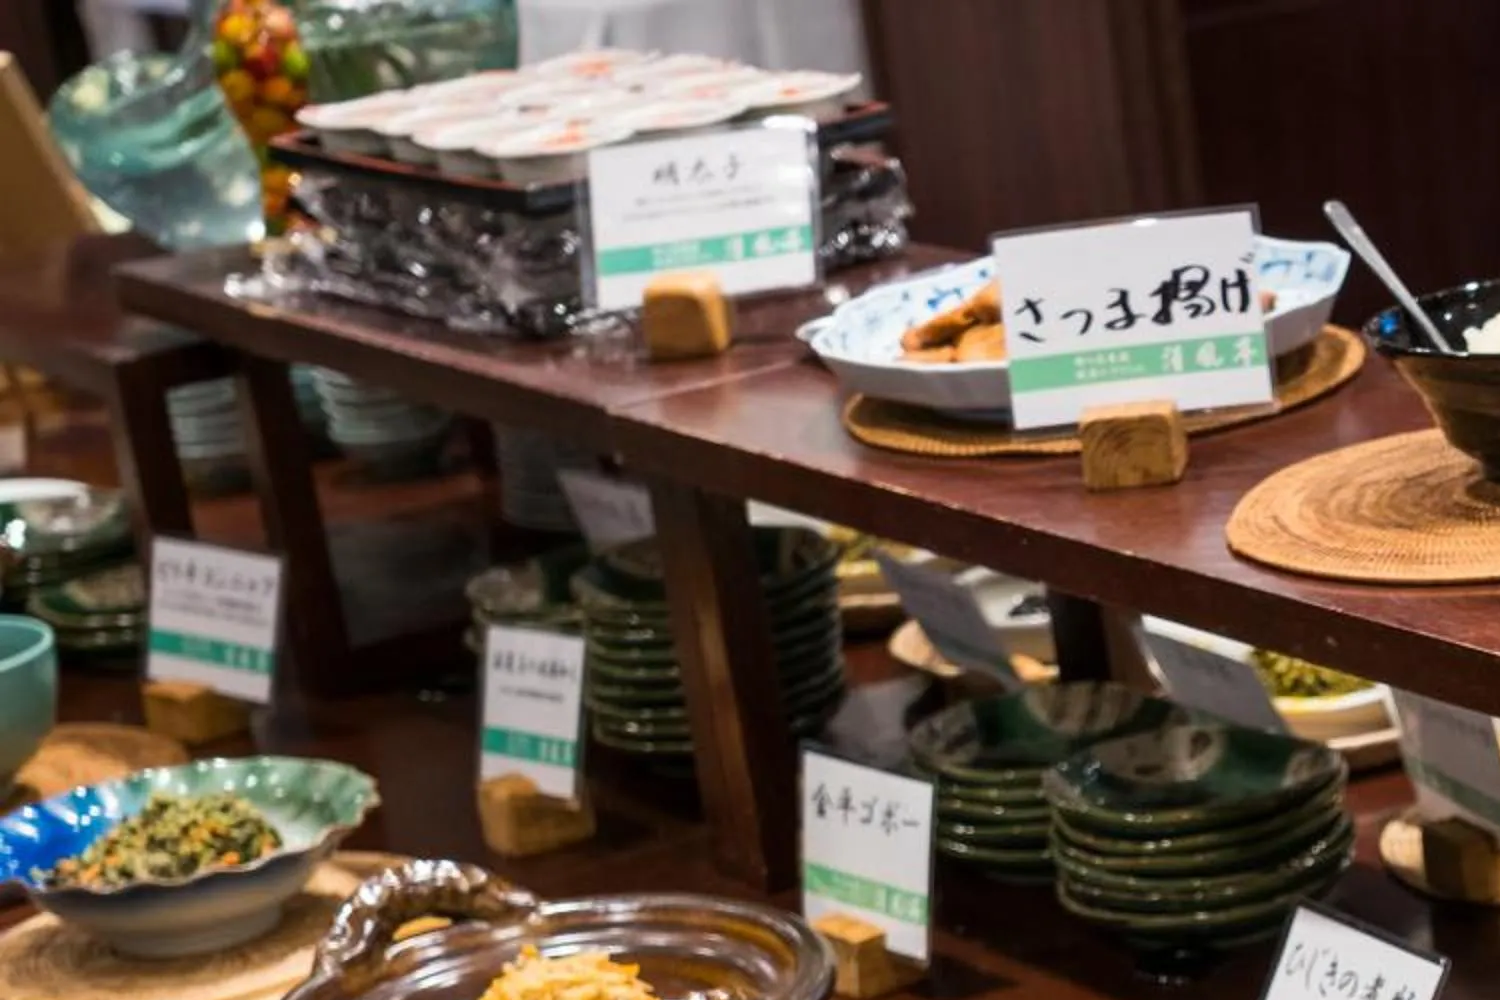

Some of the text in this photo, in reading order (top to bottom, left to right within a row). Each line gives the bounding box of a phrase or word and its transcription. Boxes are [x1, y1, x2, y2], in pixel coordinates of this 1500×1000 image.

[1014, 252, 1255, 343] さつま揚げ
